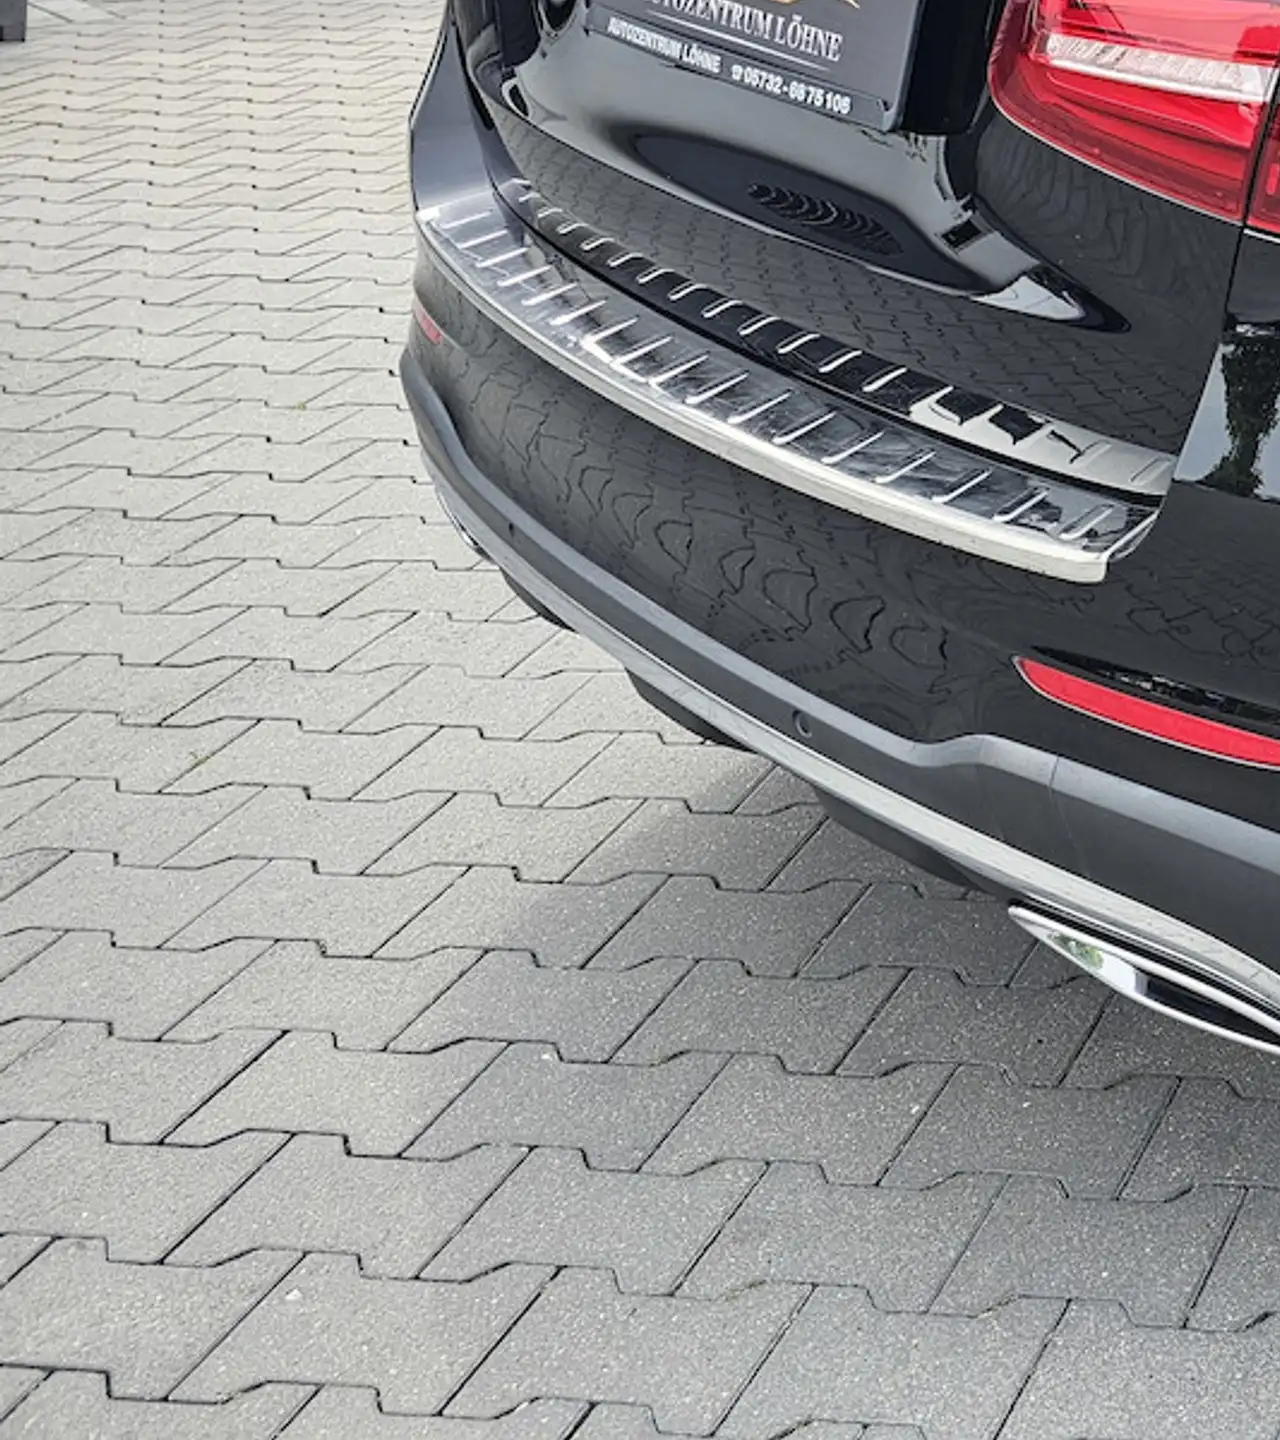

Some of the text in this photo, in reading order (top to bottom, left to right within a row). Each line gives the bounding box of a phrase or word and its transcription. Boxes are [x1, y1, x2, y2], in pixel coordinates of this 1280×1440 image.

[607, 16, 682, 60] AUTOZENTRUM
[682, 43, 721, 74] LÖHNE
[744, 66, 783, 95] 05732
[775, 14, 843, 62] LÖHNE
